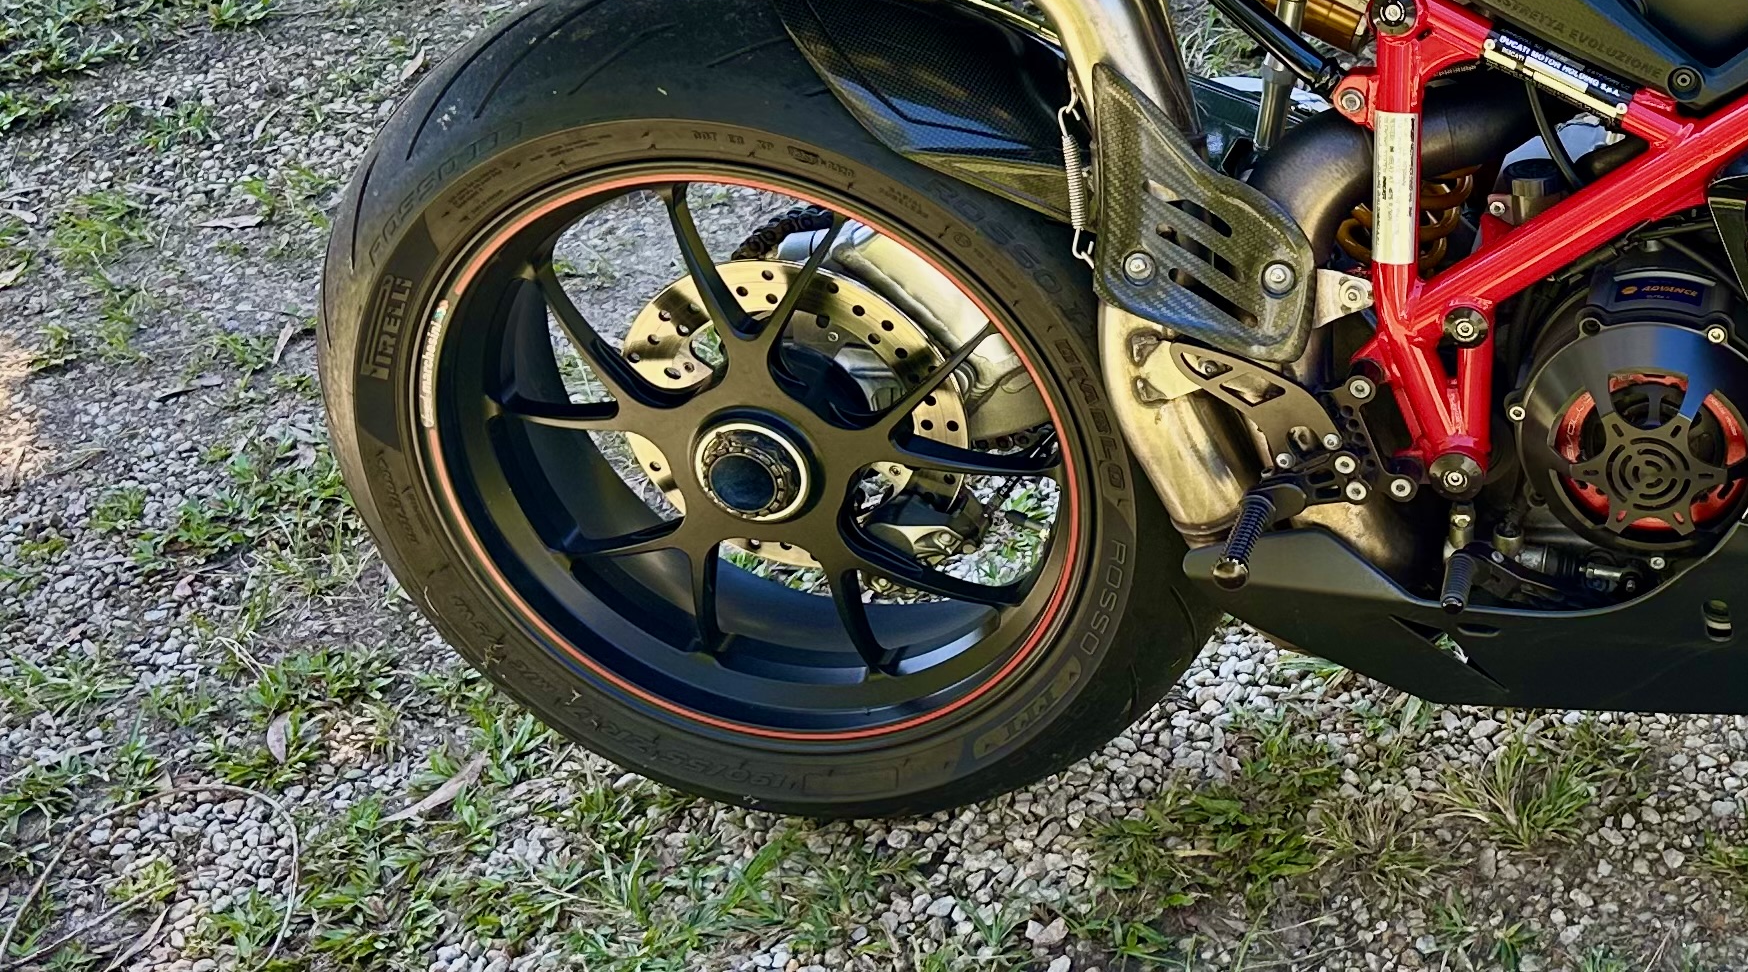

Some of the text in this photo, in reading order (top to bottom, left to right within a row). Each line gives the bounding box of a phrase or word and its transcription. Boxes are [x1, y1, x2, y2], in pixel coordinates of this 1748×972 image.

[1499, 34, 1531, 55] DUCATI
[1531, 48, 1561, 70] MOTOR
[1561, 62, 1601, 88] HOLDING
[1568, 29, 1665, 79] EVOLUZIONE
[1641, 285, 1699, 297] ADVANCE
[360, 274, 413, 381] PIRELLI
[421, 321, 442, 394] marchesini
[1054, 338, 1126, 490] DIABLO
[1080, 539, 1128, 656] ROSSO
[1002, 687, 1058, 741] III
